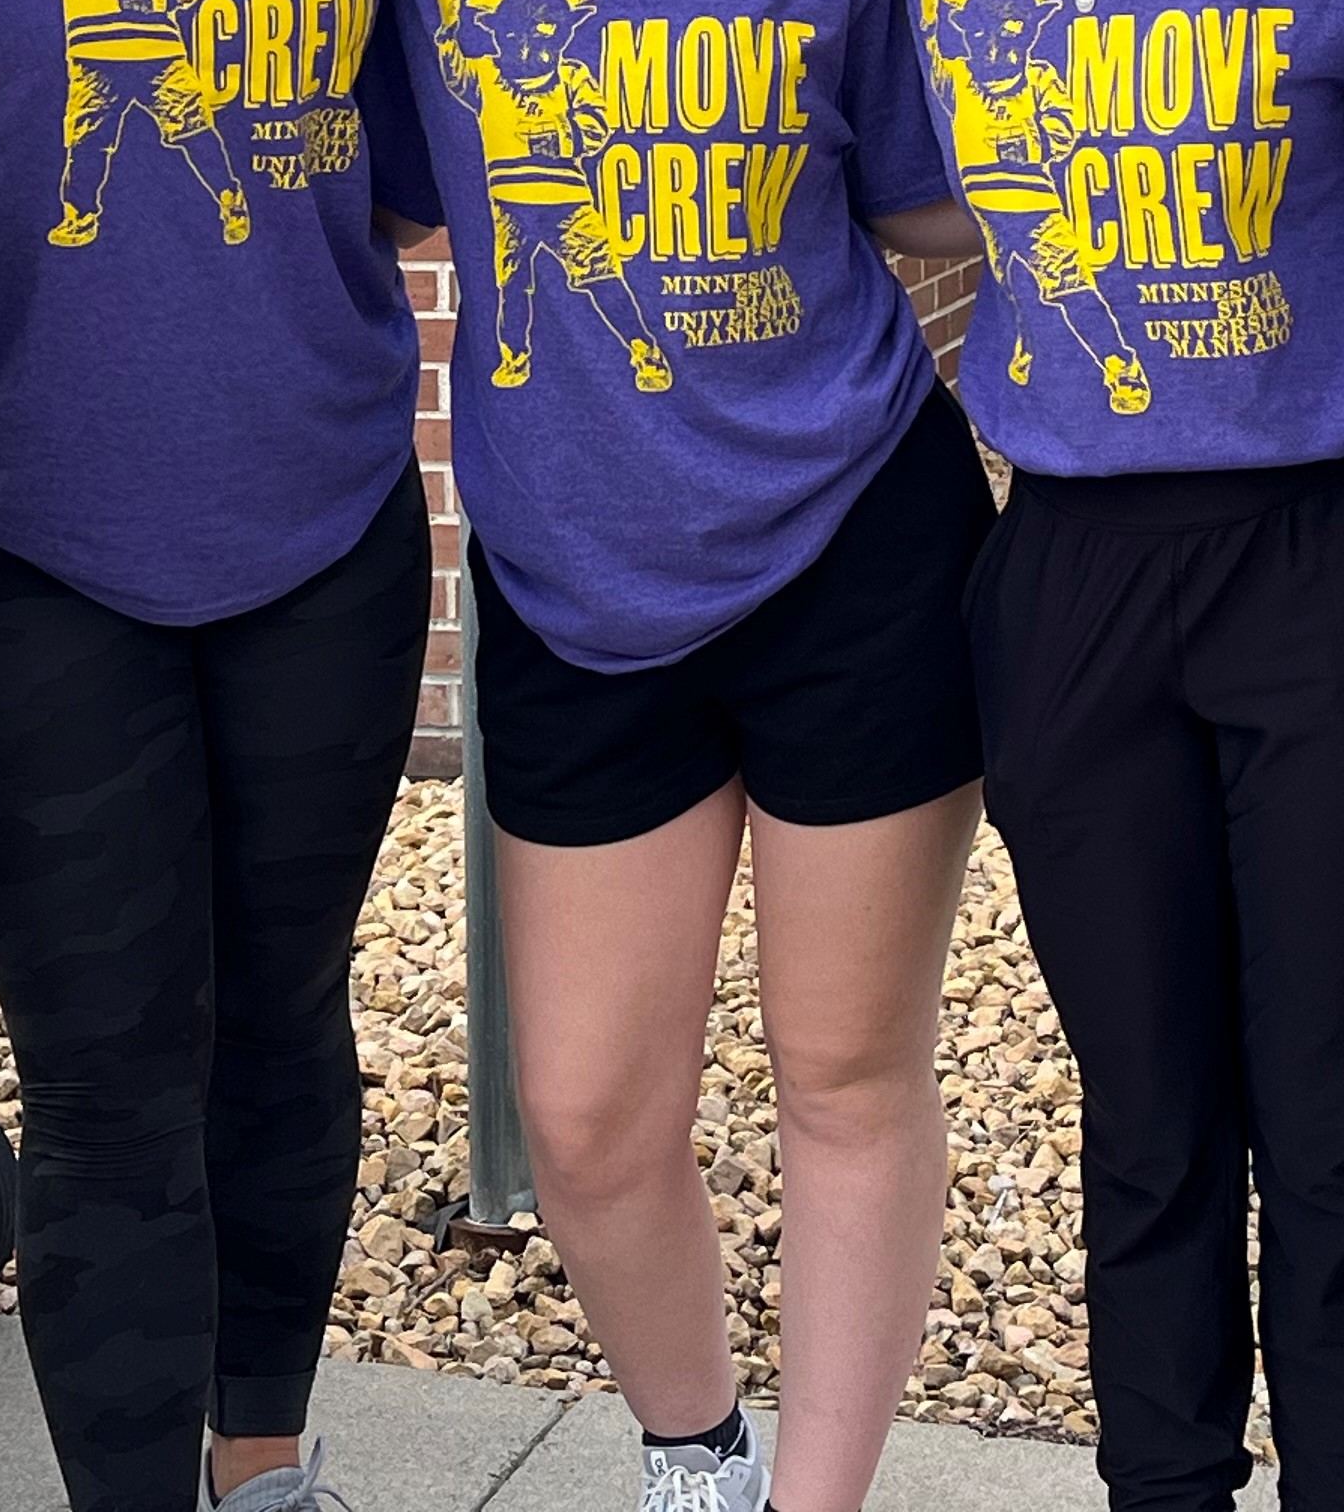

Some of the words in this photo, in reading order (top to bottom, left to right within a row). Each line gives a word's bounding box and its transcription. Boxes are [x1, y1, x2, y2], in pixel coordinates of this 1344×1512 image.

[600, 16, 815, 134] MOVE
[1067, 7, 1295, 137] MOVE
[599, 144, 808, 262] CREW
[1067, 138, 1292, 272] CREW
[661, 264, 793, 295] MINNESOTA
[736, 281, 794, 308] STATE
[1136, 270, 1281, 304] MINNESOTA
[1217, 291, 1286, 320] STATE
[684, 316, 800, 348] MANKATO
[1169, 326, 1291, 358] MANKATO
